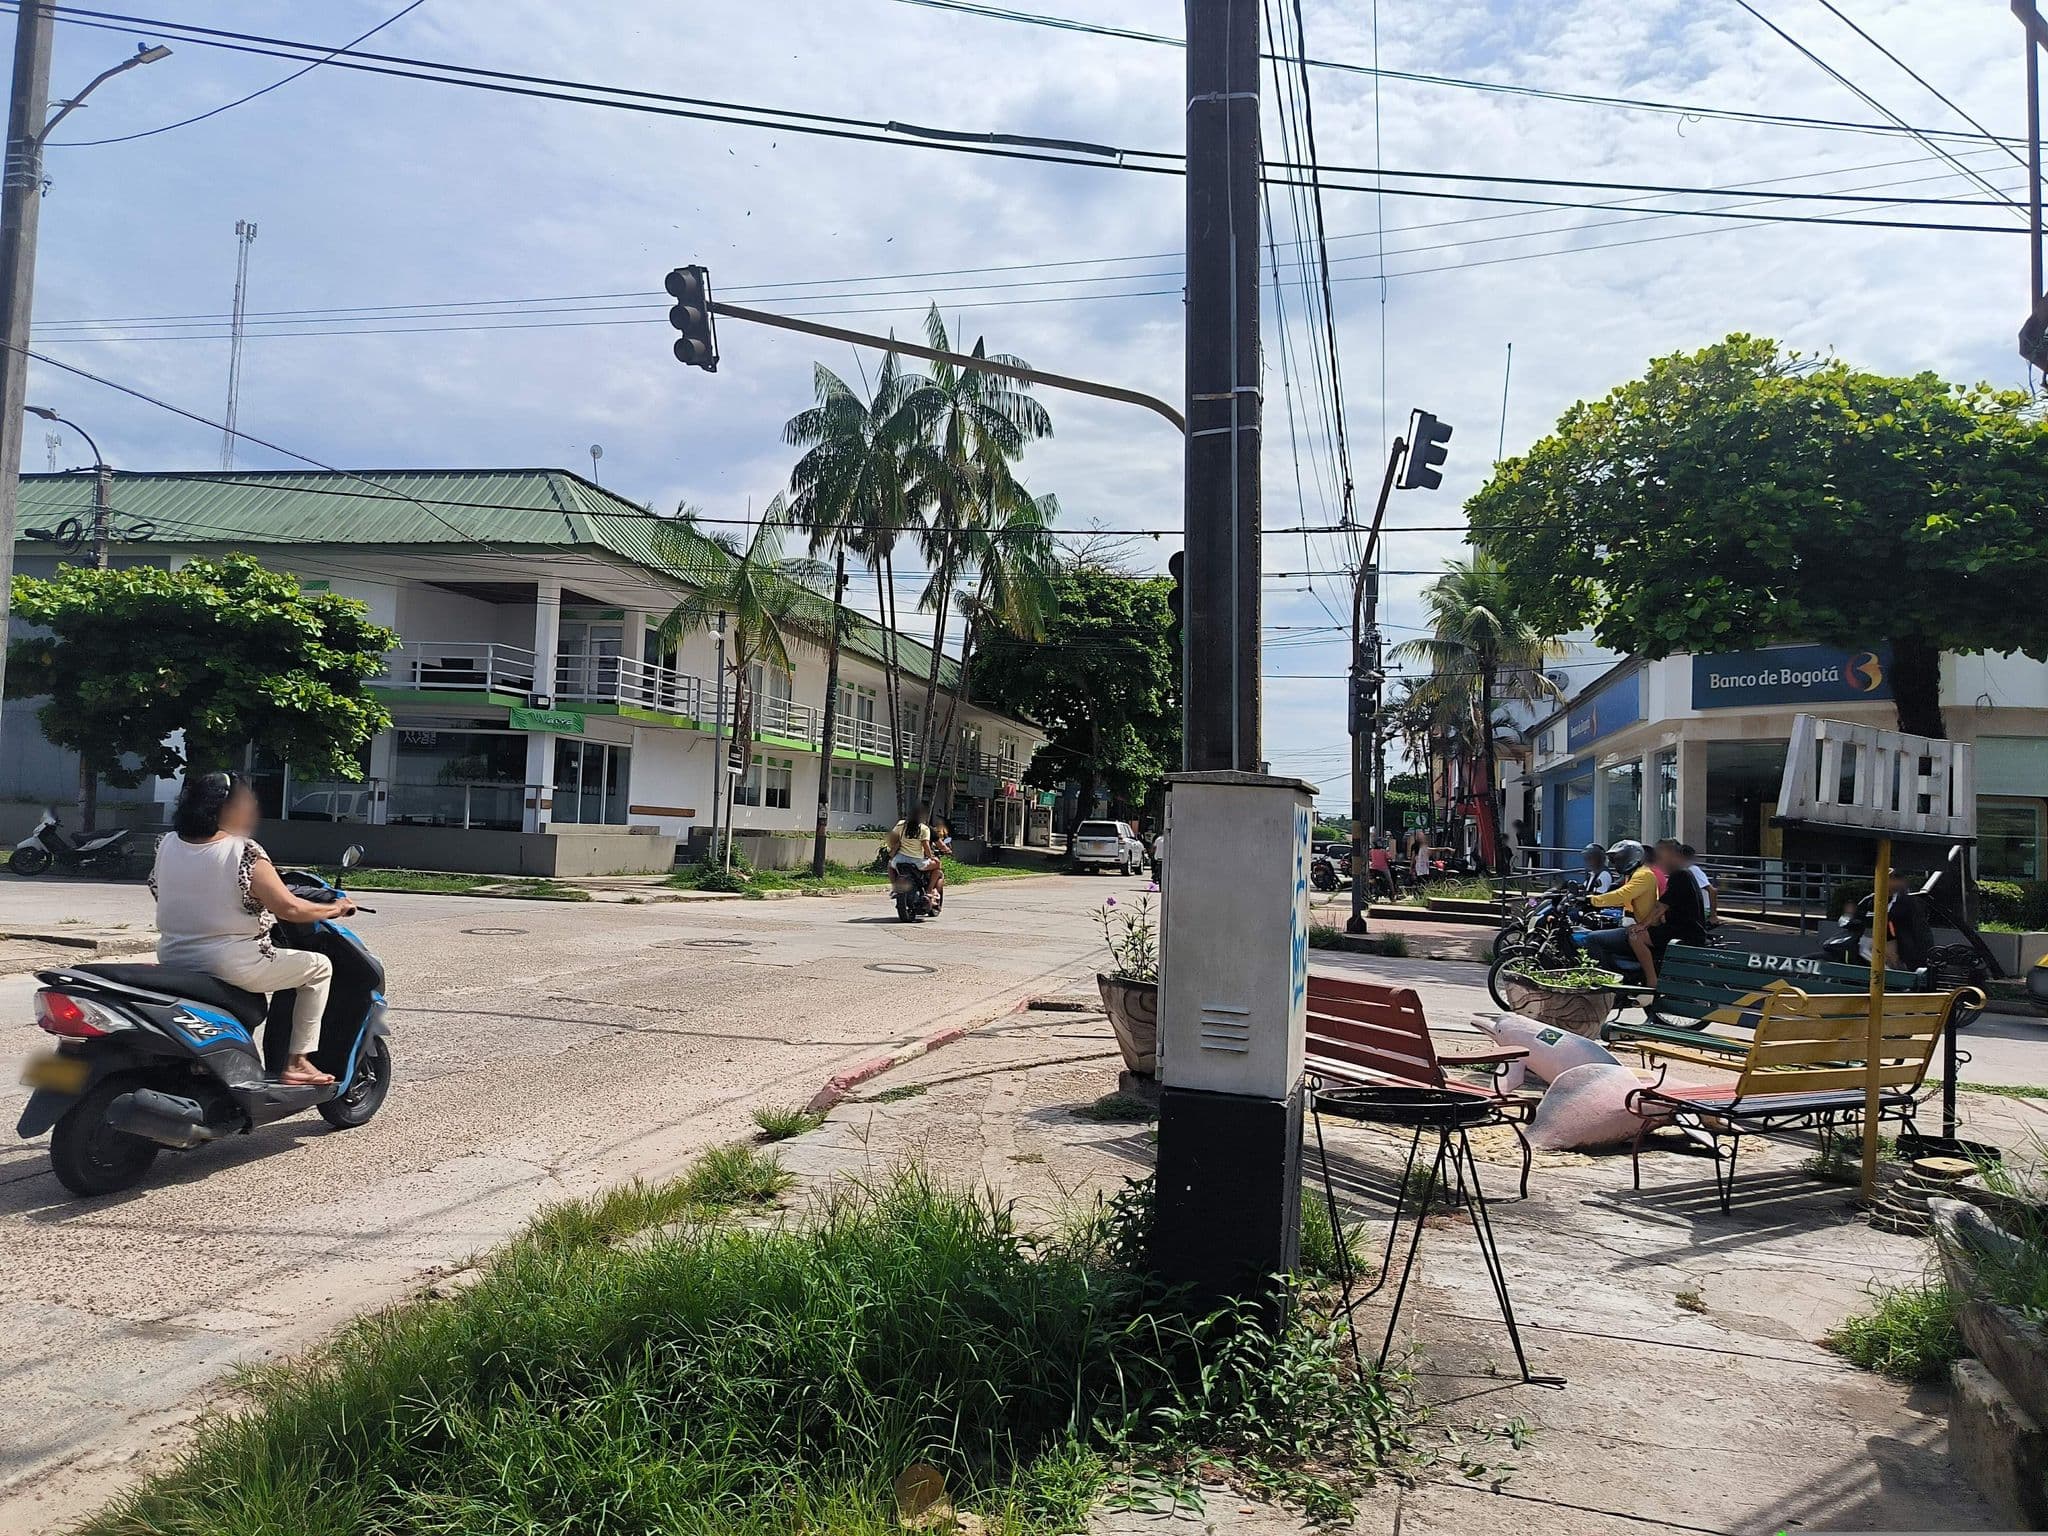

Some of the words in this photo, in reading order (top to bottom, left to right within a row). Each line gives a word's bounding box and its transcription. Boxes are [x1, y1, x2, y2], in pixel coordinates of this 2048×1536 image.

[1710, 672, 1756, 689] Banco
[1759, 670, 1778, 686] de
[1780, 665, 1839, 687] Bogotá
[1748, 953, 1822, 975] BRASIL
